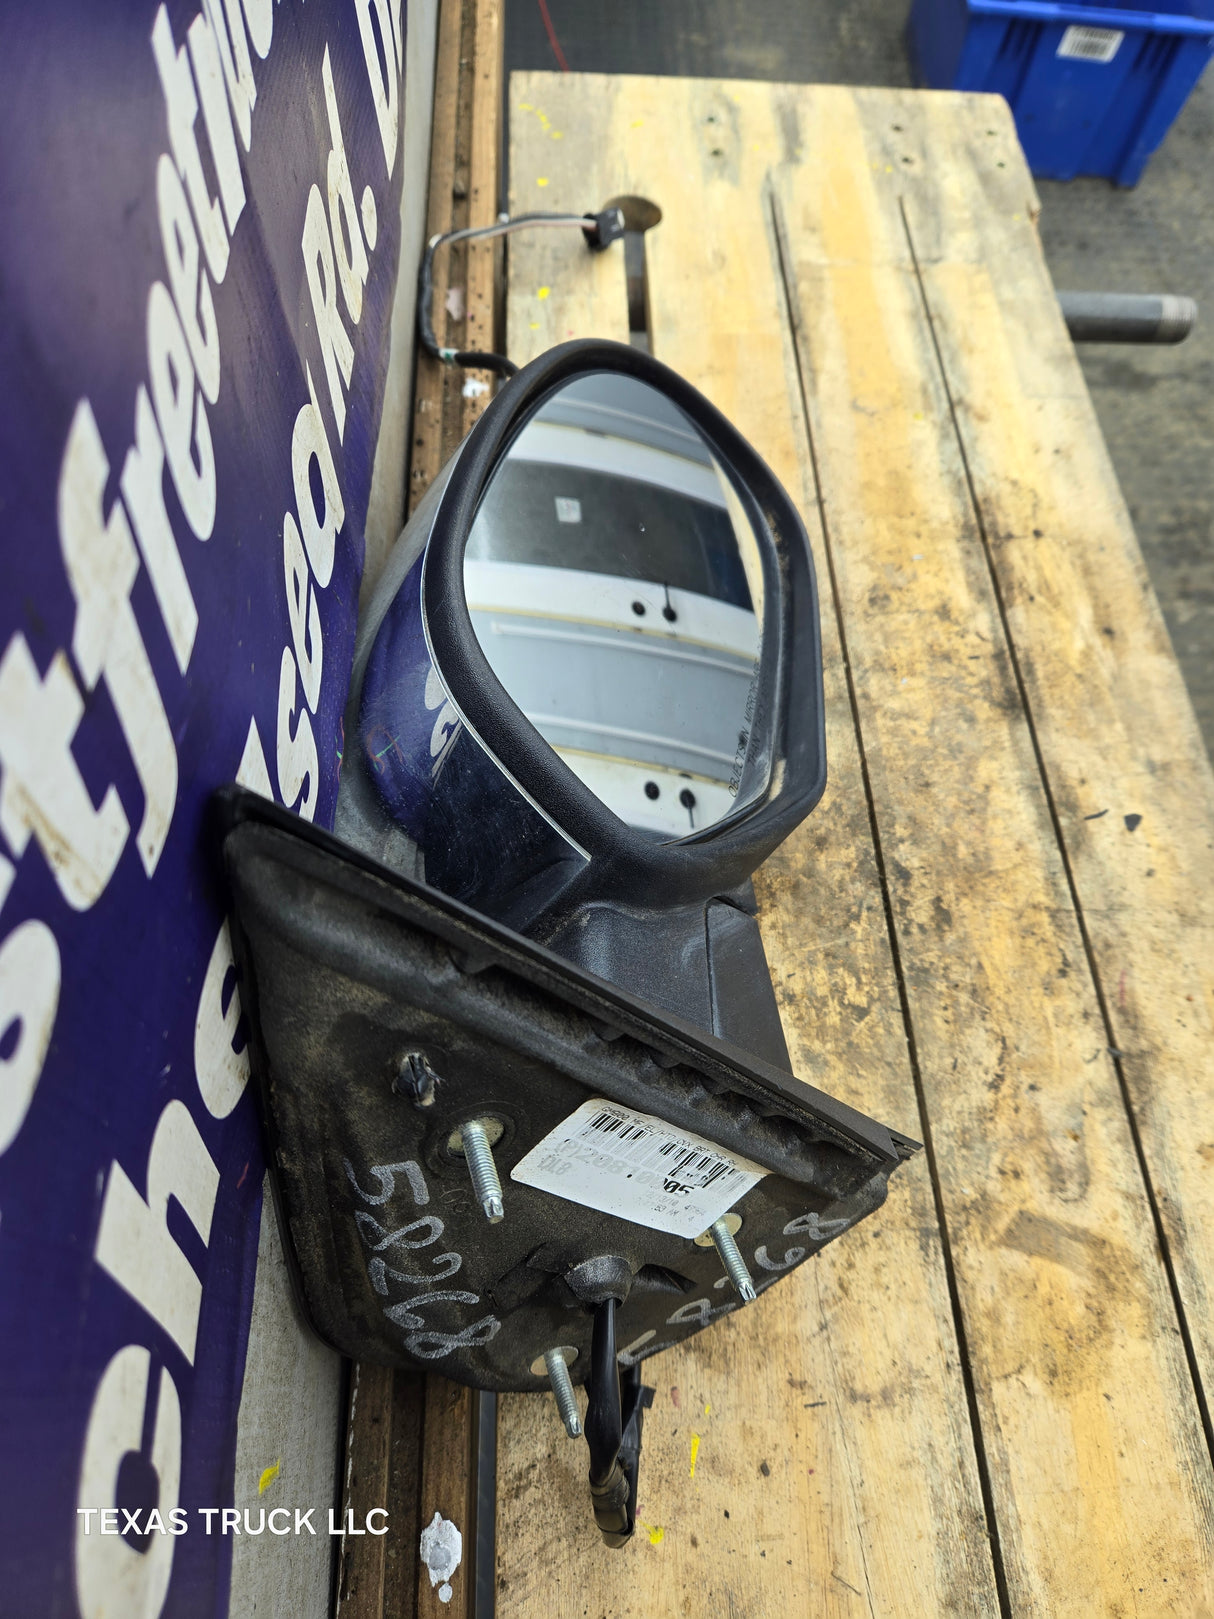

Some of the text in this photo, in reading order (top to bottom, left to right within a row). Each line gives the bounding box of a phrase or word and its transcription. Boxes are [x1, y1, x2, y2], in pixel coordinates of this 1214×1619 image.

[301, 42, 378, 447] Rd.
[728, 741, 746, 798] OBJECTS
[343, 1159, 502, 1360] 58268
